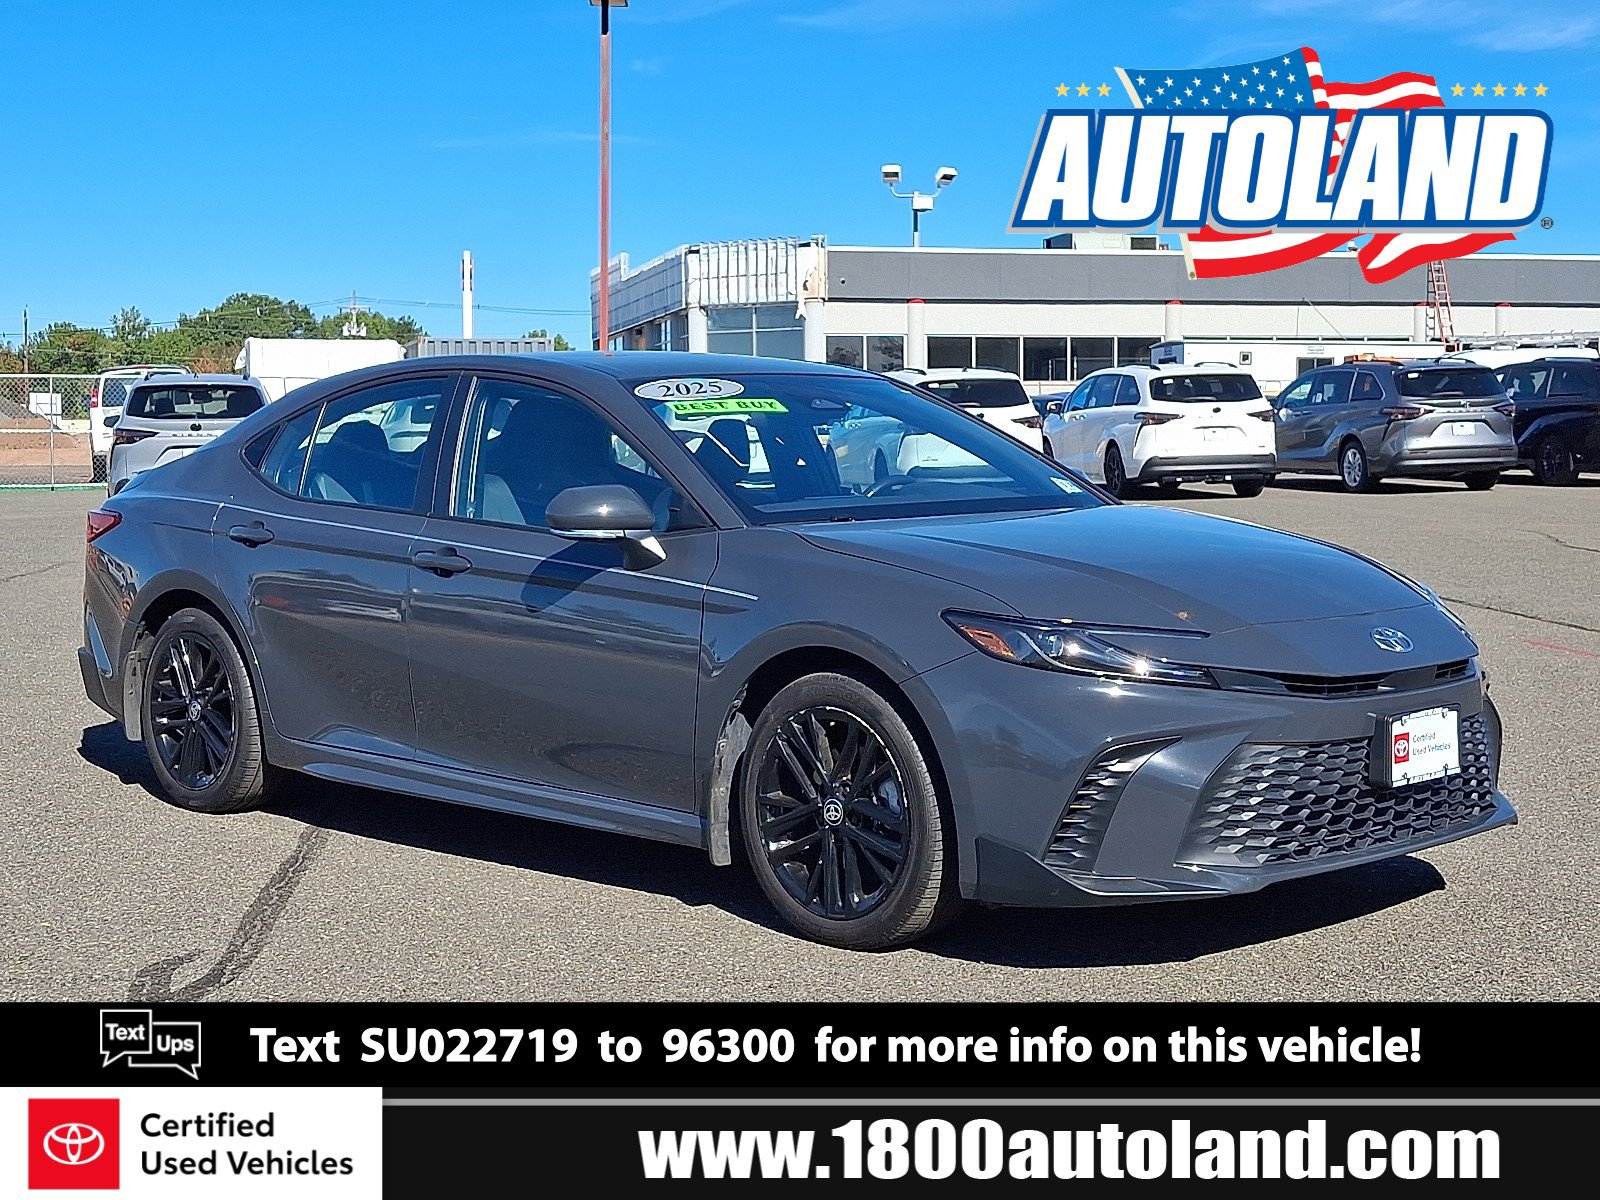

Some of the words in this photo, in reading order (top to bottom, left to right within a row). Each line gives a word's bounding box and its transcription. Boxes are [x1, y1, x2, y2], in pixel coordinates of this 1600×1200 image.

[657, 381, 723, 398] 2025
[673, 401, 729, 411] BEST
[737, 401, 777, 409] BUY
